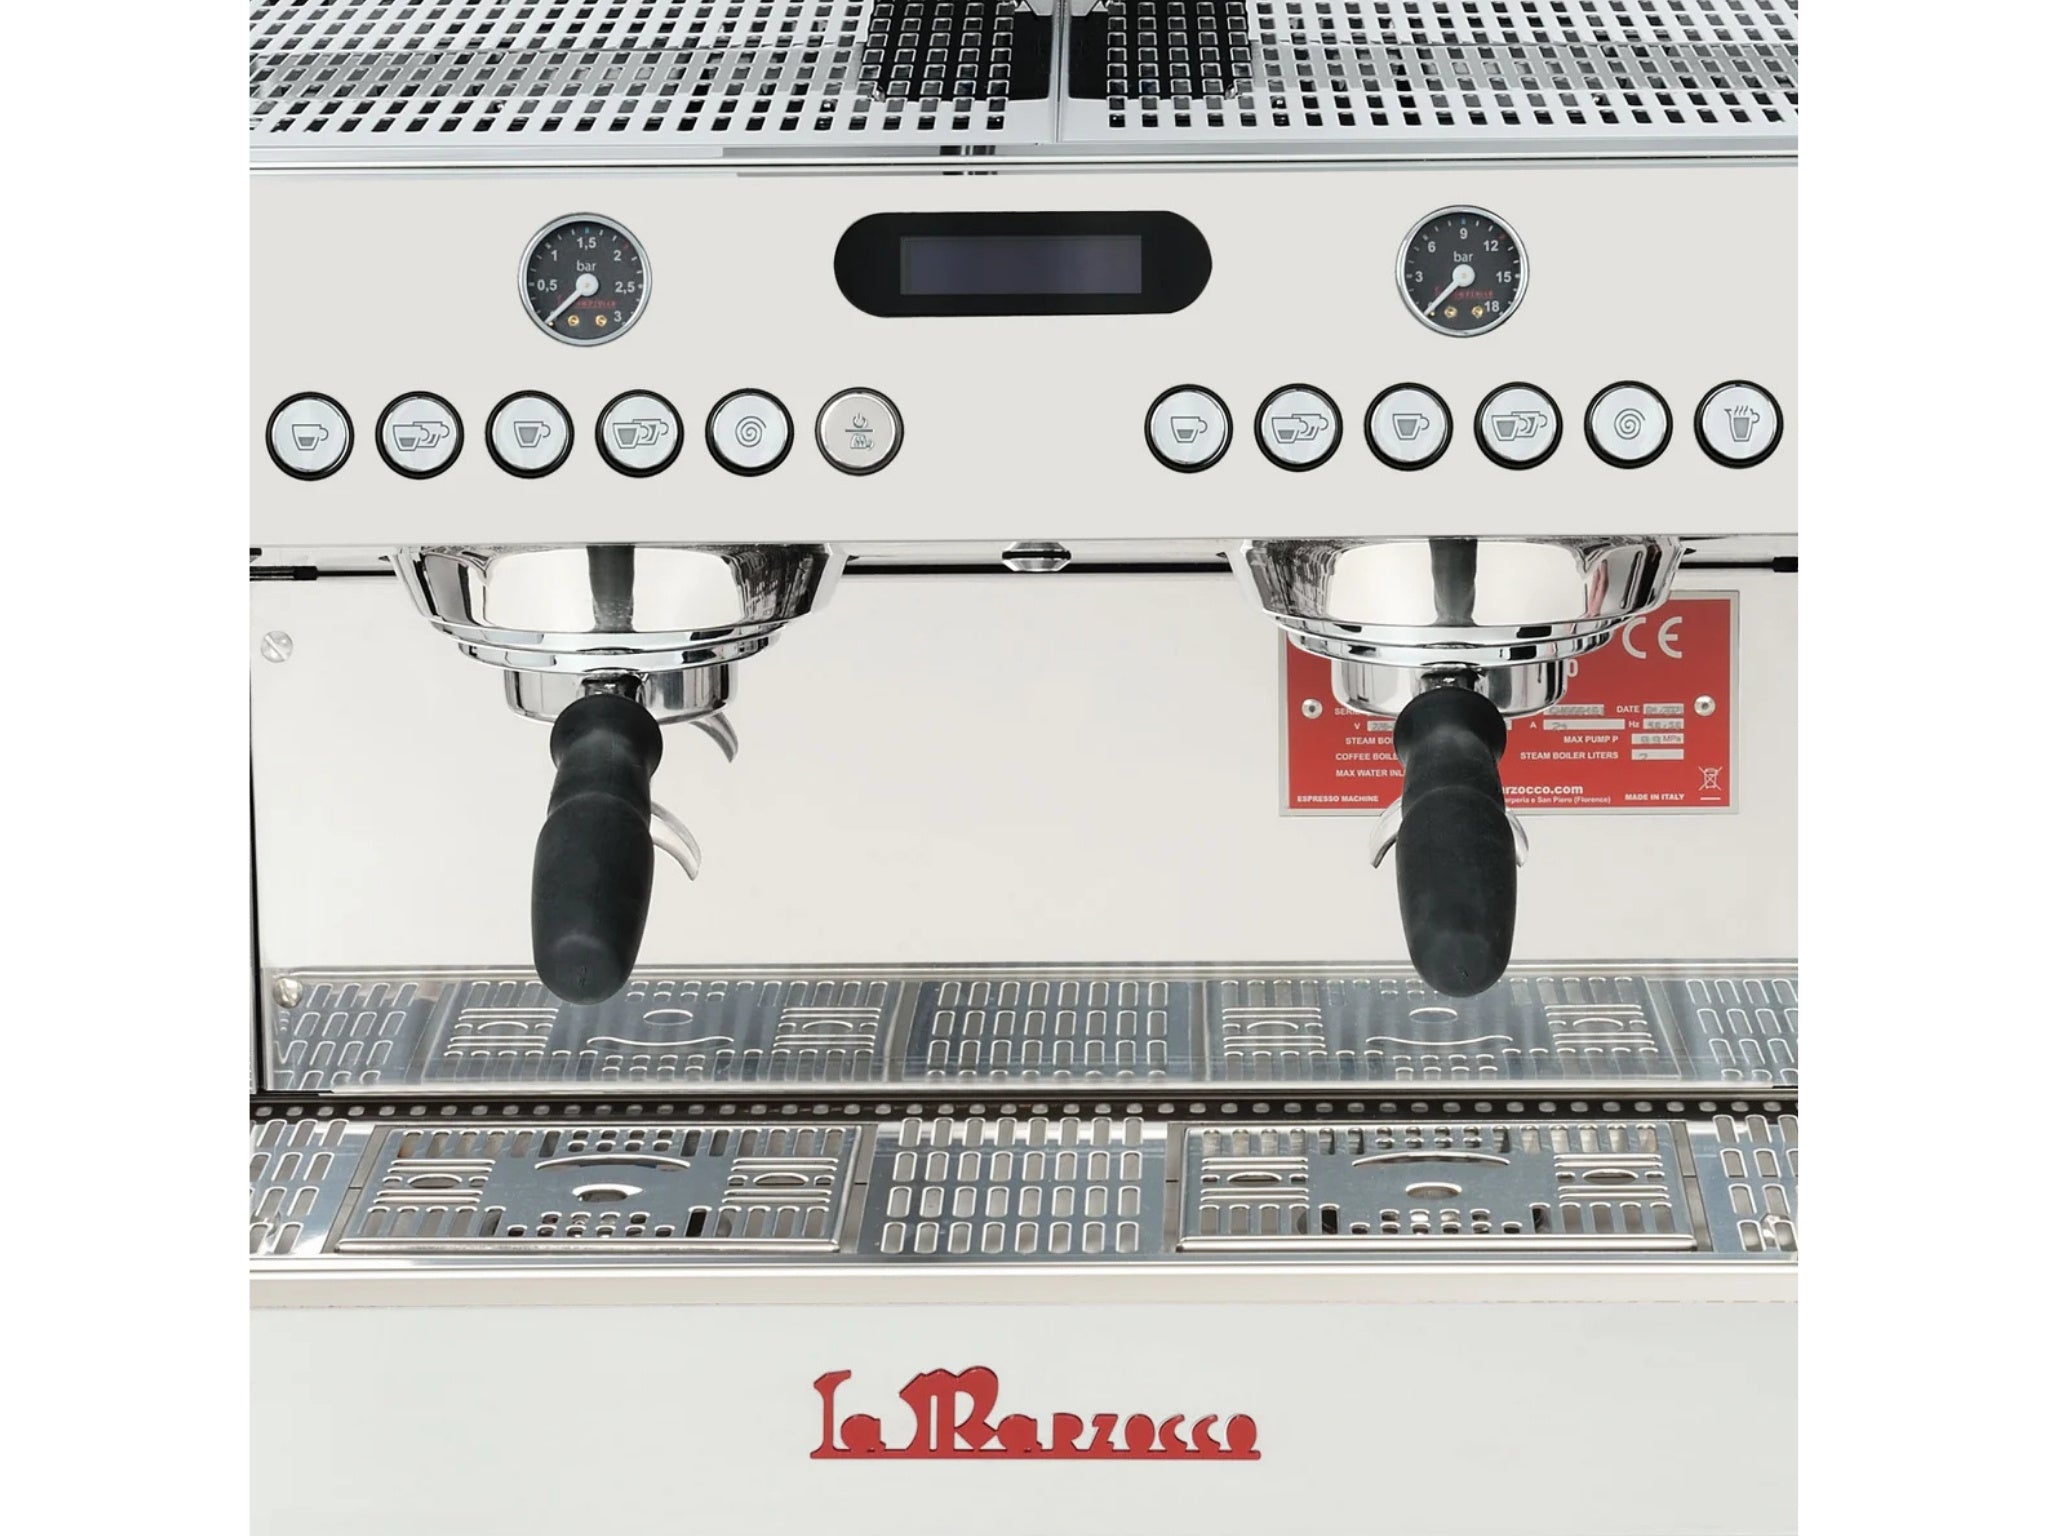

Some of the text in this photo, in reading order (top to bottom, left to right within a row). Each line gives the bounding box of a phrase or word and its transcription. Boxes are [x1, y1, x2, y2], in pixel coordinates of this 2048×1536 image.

[1459, 228, 1468, 240] 9
[576, 236, 597, 250] 1,5
[1427, 241, 1436, 252] 6
[1483, 240, 1499, 252] 12
[551, 250, 558, 261] 1
[613, 250, 622, 261] 2
[1453, 251, 1473, 263] bar
[576, 260, 597, 272] bar
[1415, 271, 1424, 282] 3
[1496, 271, 1512, 283] 15
[537, 279, 558, 292] 0,5
[615, 281, 635, 294] 2,5
[1484, 301, 1500, 312] 18
[614, 310, 622, 322] 3
[1622, 616, 1683, 659] CE
[1616, 705, 1640, 714] DATE
[1353, 722, 1361, 730] V
[1530, 721, 1537, 729] A
[1628, 720, 1640, 729] Hz
[1345, 736, 1394, 745] STEAM BOI
[1563, 735, 1619, 744] MAX PUMP P
[1335, 752, 1399, 761] COFFEE BOILE
[1520, 751, 1619, 761] STEAM BOILER LITERS
[1336, 769, 1356, 778] MAX
[1357, 769, 1388, 778] WATER
[1297, 794, 1379, 803] ESPRESSO MACHINE
[1624, 793, 1685, 801] MADE IN ITALY
